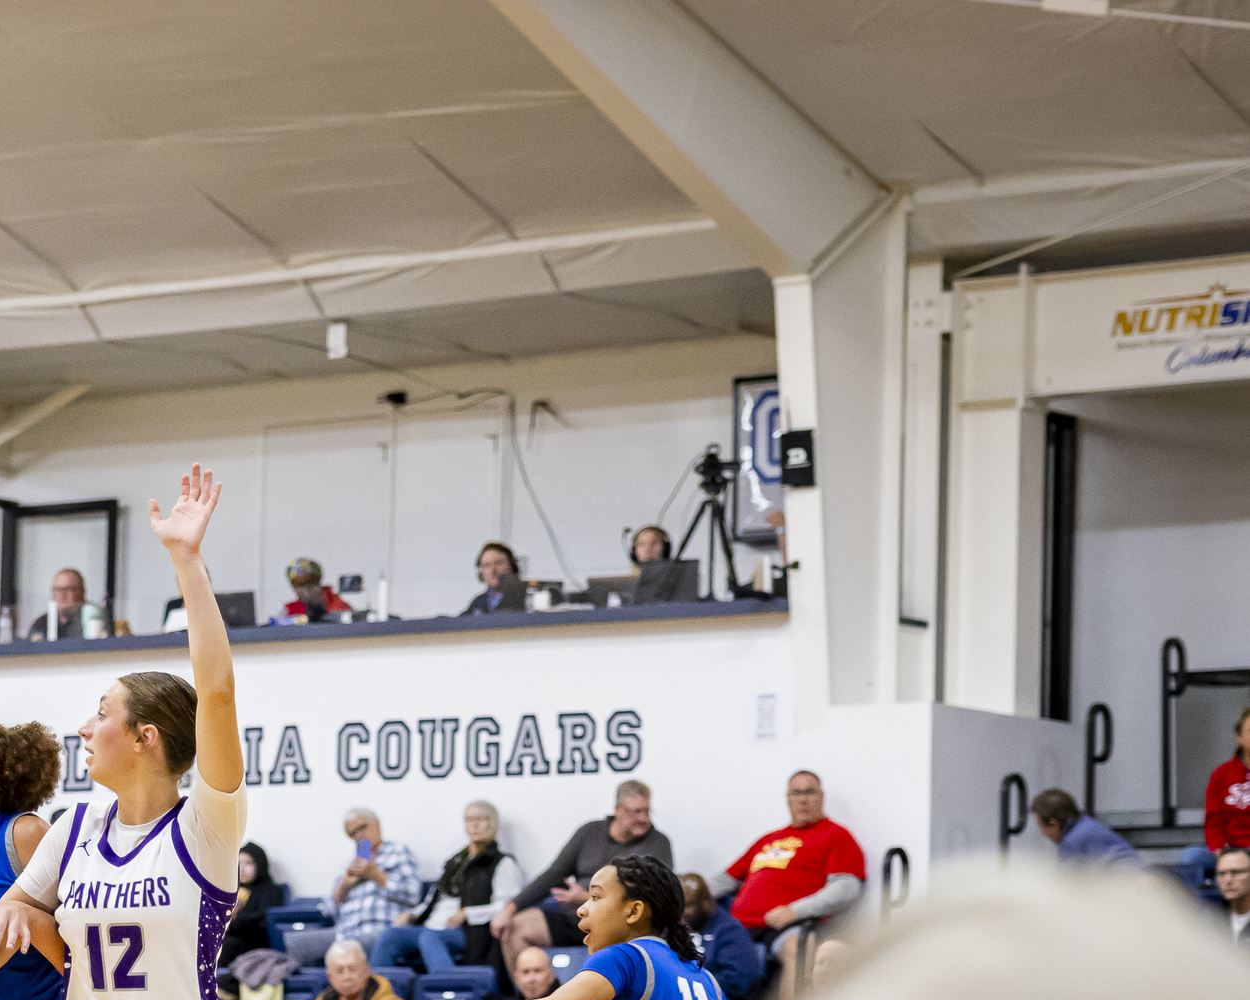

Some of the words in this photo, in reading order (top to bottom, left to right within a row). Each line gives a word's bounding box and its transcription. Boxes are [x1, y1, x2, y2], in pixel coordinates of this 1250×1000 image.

[337, 710, 642, 782] COUGARS
[64, 876, 171, 909] PANTHERS
[84, 922, 148, 992] 12
